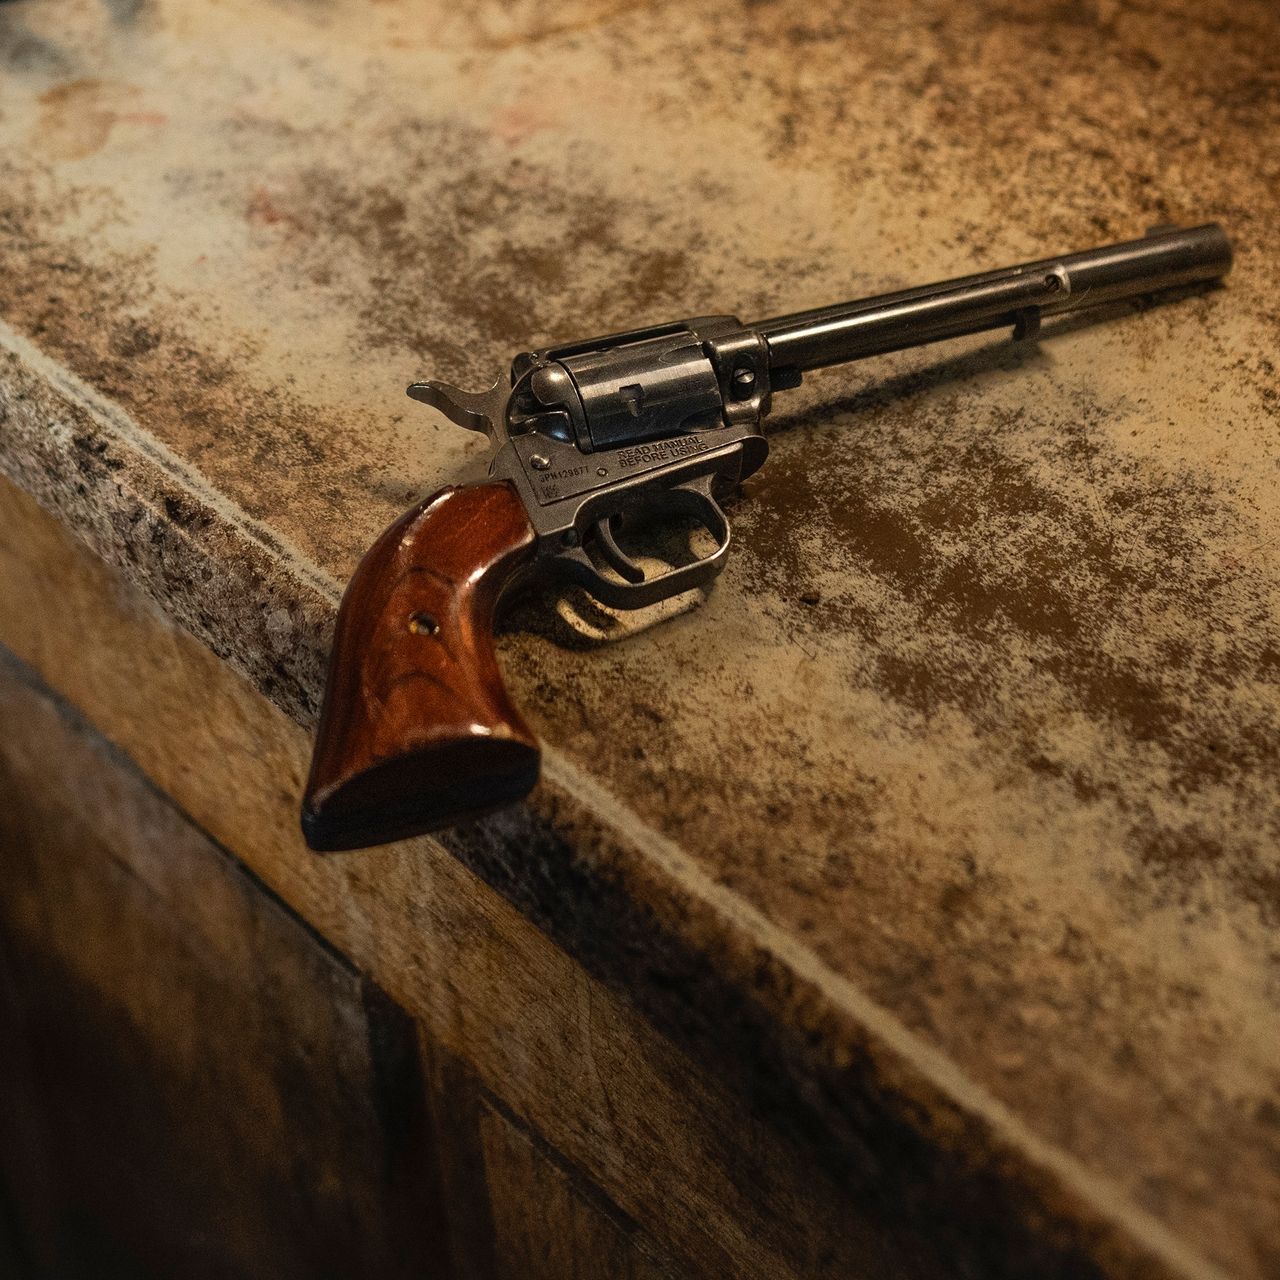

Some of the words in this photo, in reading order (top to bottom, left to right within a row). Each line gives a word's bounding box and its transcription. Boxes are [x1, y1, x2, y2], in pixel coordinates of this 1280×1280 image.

[617, 443, 652, 460] READ
[653, 435, 703, 454] MANUAL
[618, 450, 668, 468] BEFORE
[670, 442, 710, 457] USING
